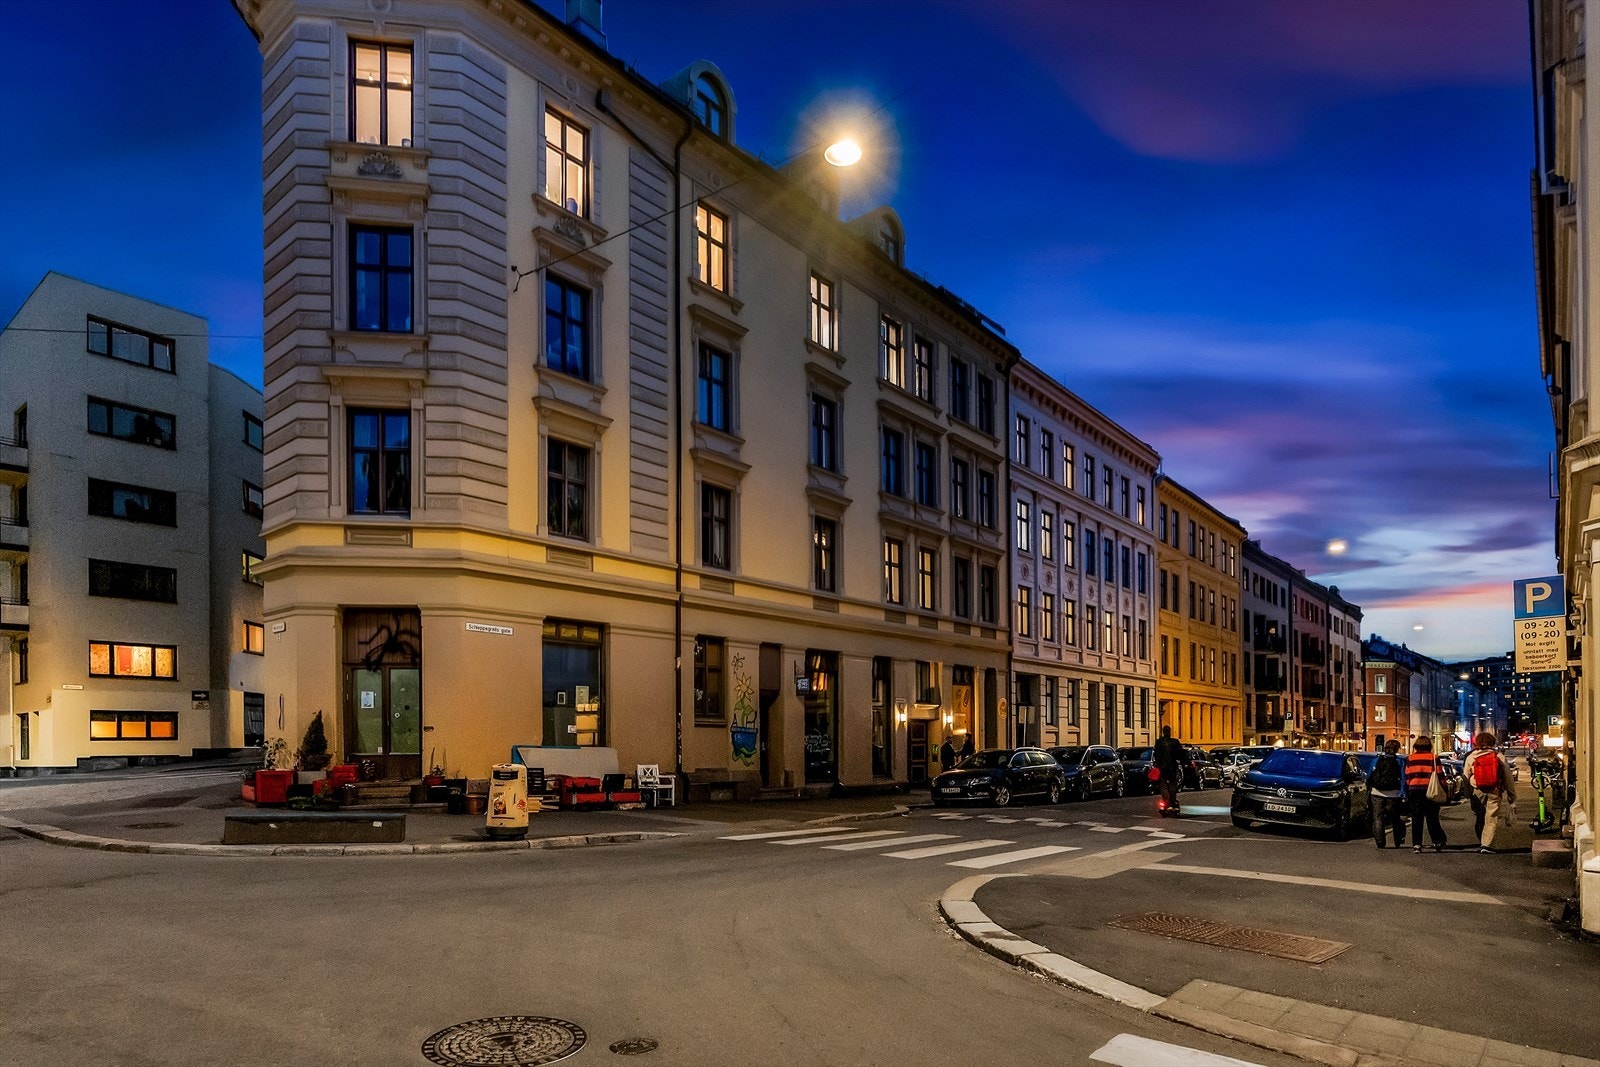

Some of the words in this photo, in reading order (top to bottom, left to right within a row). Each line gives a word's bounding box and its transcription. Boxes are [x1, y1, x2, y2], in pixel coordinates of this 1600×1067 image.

[1525, 582, 1552, 614] P
[1543, 620, 1556, 628] 20
[1520, 632, 1537, 640] (09
[1543, 630, 1560, 638] 20)
